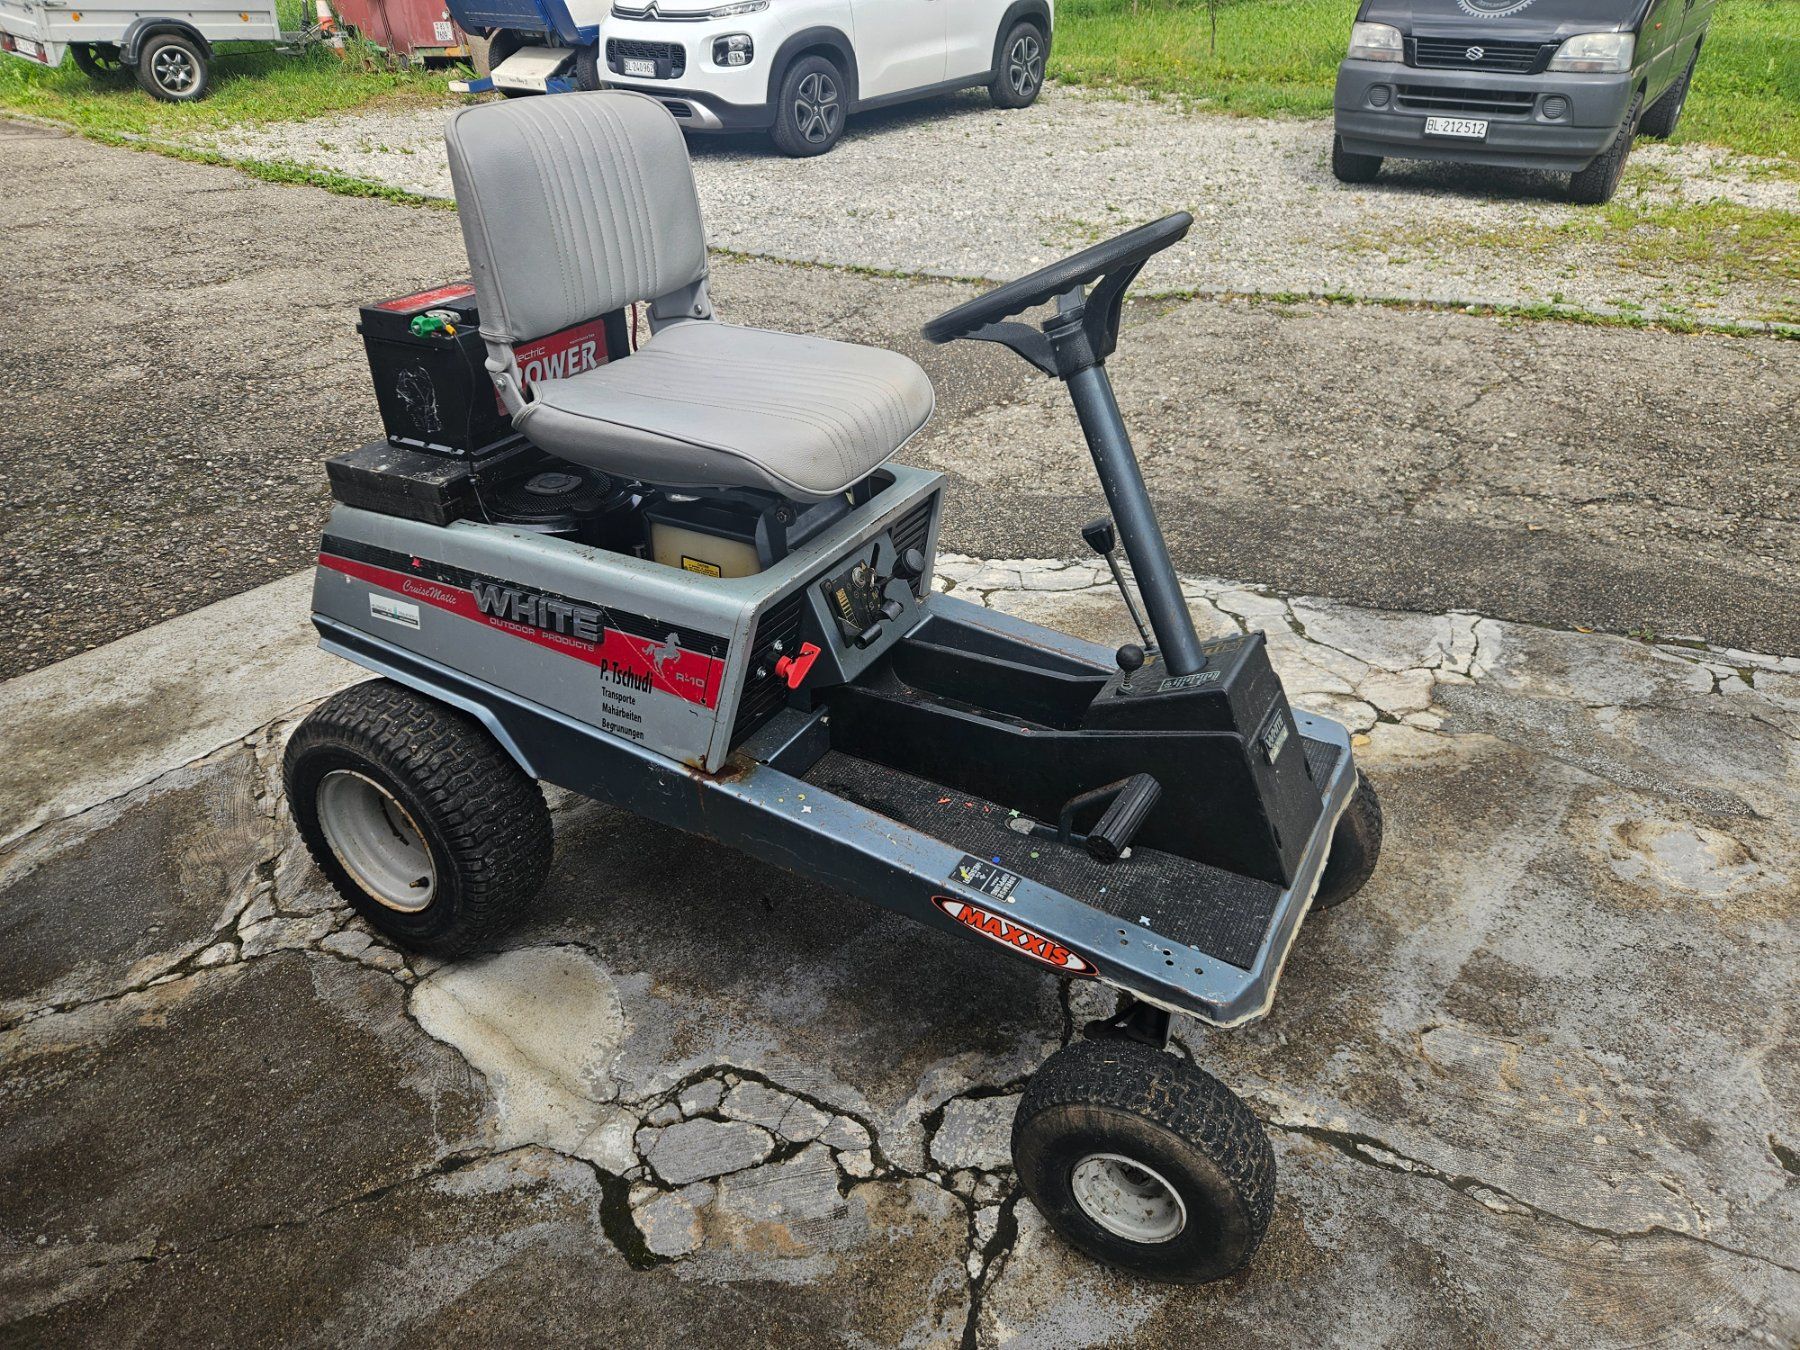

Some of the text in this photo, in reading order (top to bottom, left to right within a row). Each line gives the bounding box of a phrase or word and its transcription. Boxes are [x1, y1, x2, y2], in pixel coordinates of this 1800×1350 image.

[402, 580, 457, 605] CruiseMatic
[470, 578, 603, 643] WHITE
[489, 617, 595, 652] OUTDOOR PRODUCTS
[600, 658, 654, 695] P. Tschudi
[675, 672, 706, 688] R-10
[601, 686, 636, 706] Transporte
[958, 906, 1069, 965] MAXXIS
